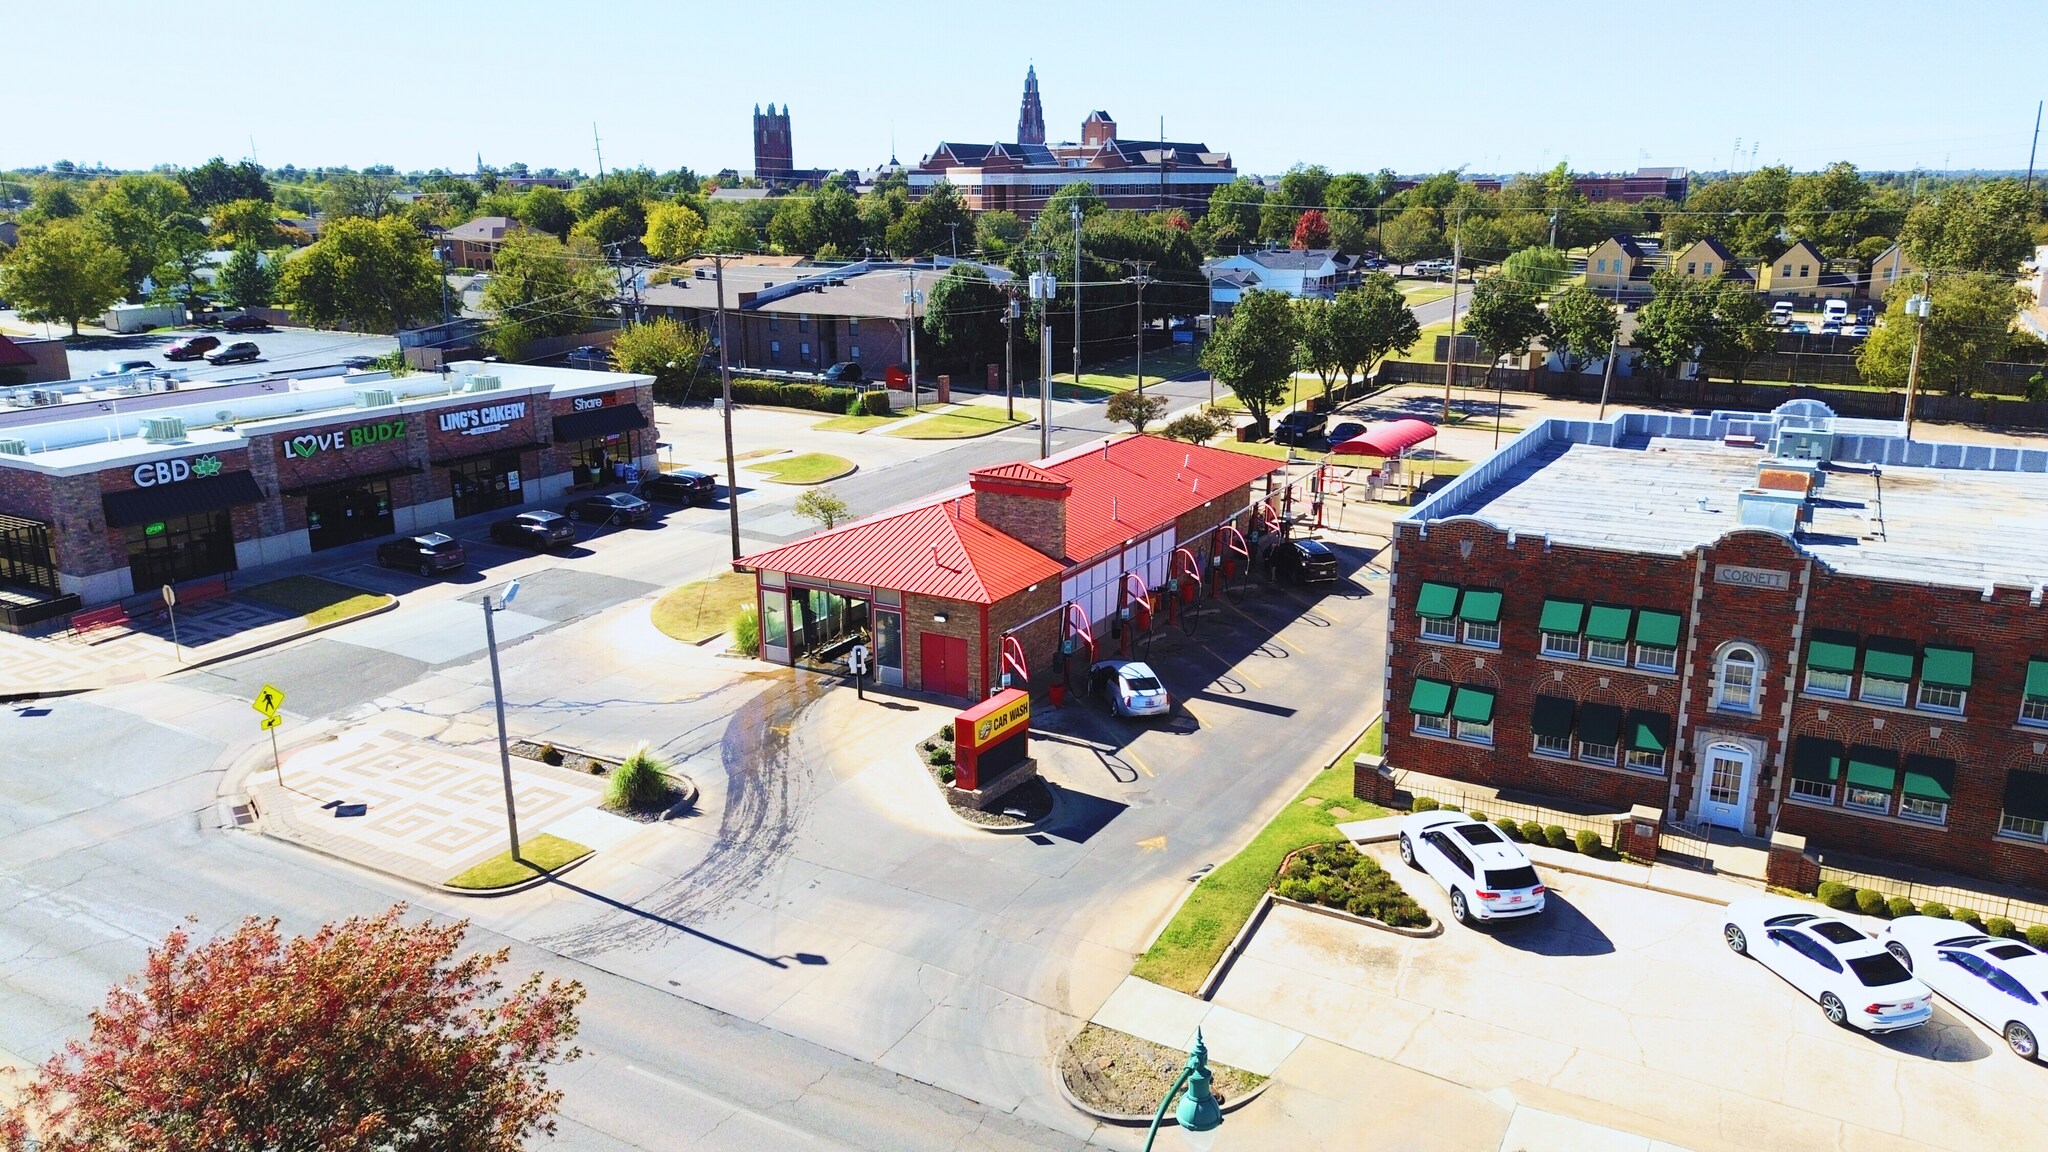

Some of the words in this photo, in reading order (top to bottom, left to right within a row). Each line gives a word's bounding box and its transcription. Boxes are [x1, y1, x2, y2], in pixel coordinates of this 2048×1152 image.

[439, 409, 479, 432] LING'S
[481, 402, 525, 424] CAKERY
[283, 431, 345, 459] LOVE
[350, 421, 406, 447] BUDZ
[133, 459, 190, 487] CBD
[1722, 568, 1783, 586] CORNETT
[993, 714, 1008, 731] CAR
[1009, 703, 1028, 721] WASH
